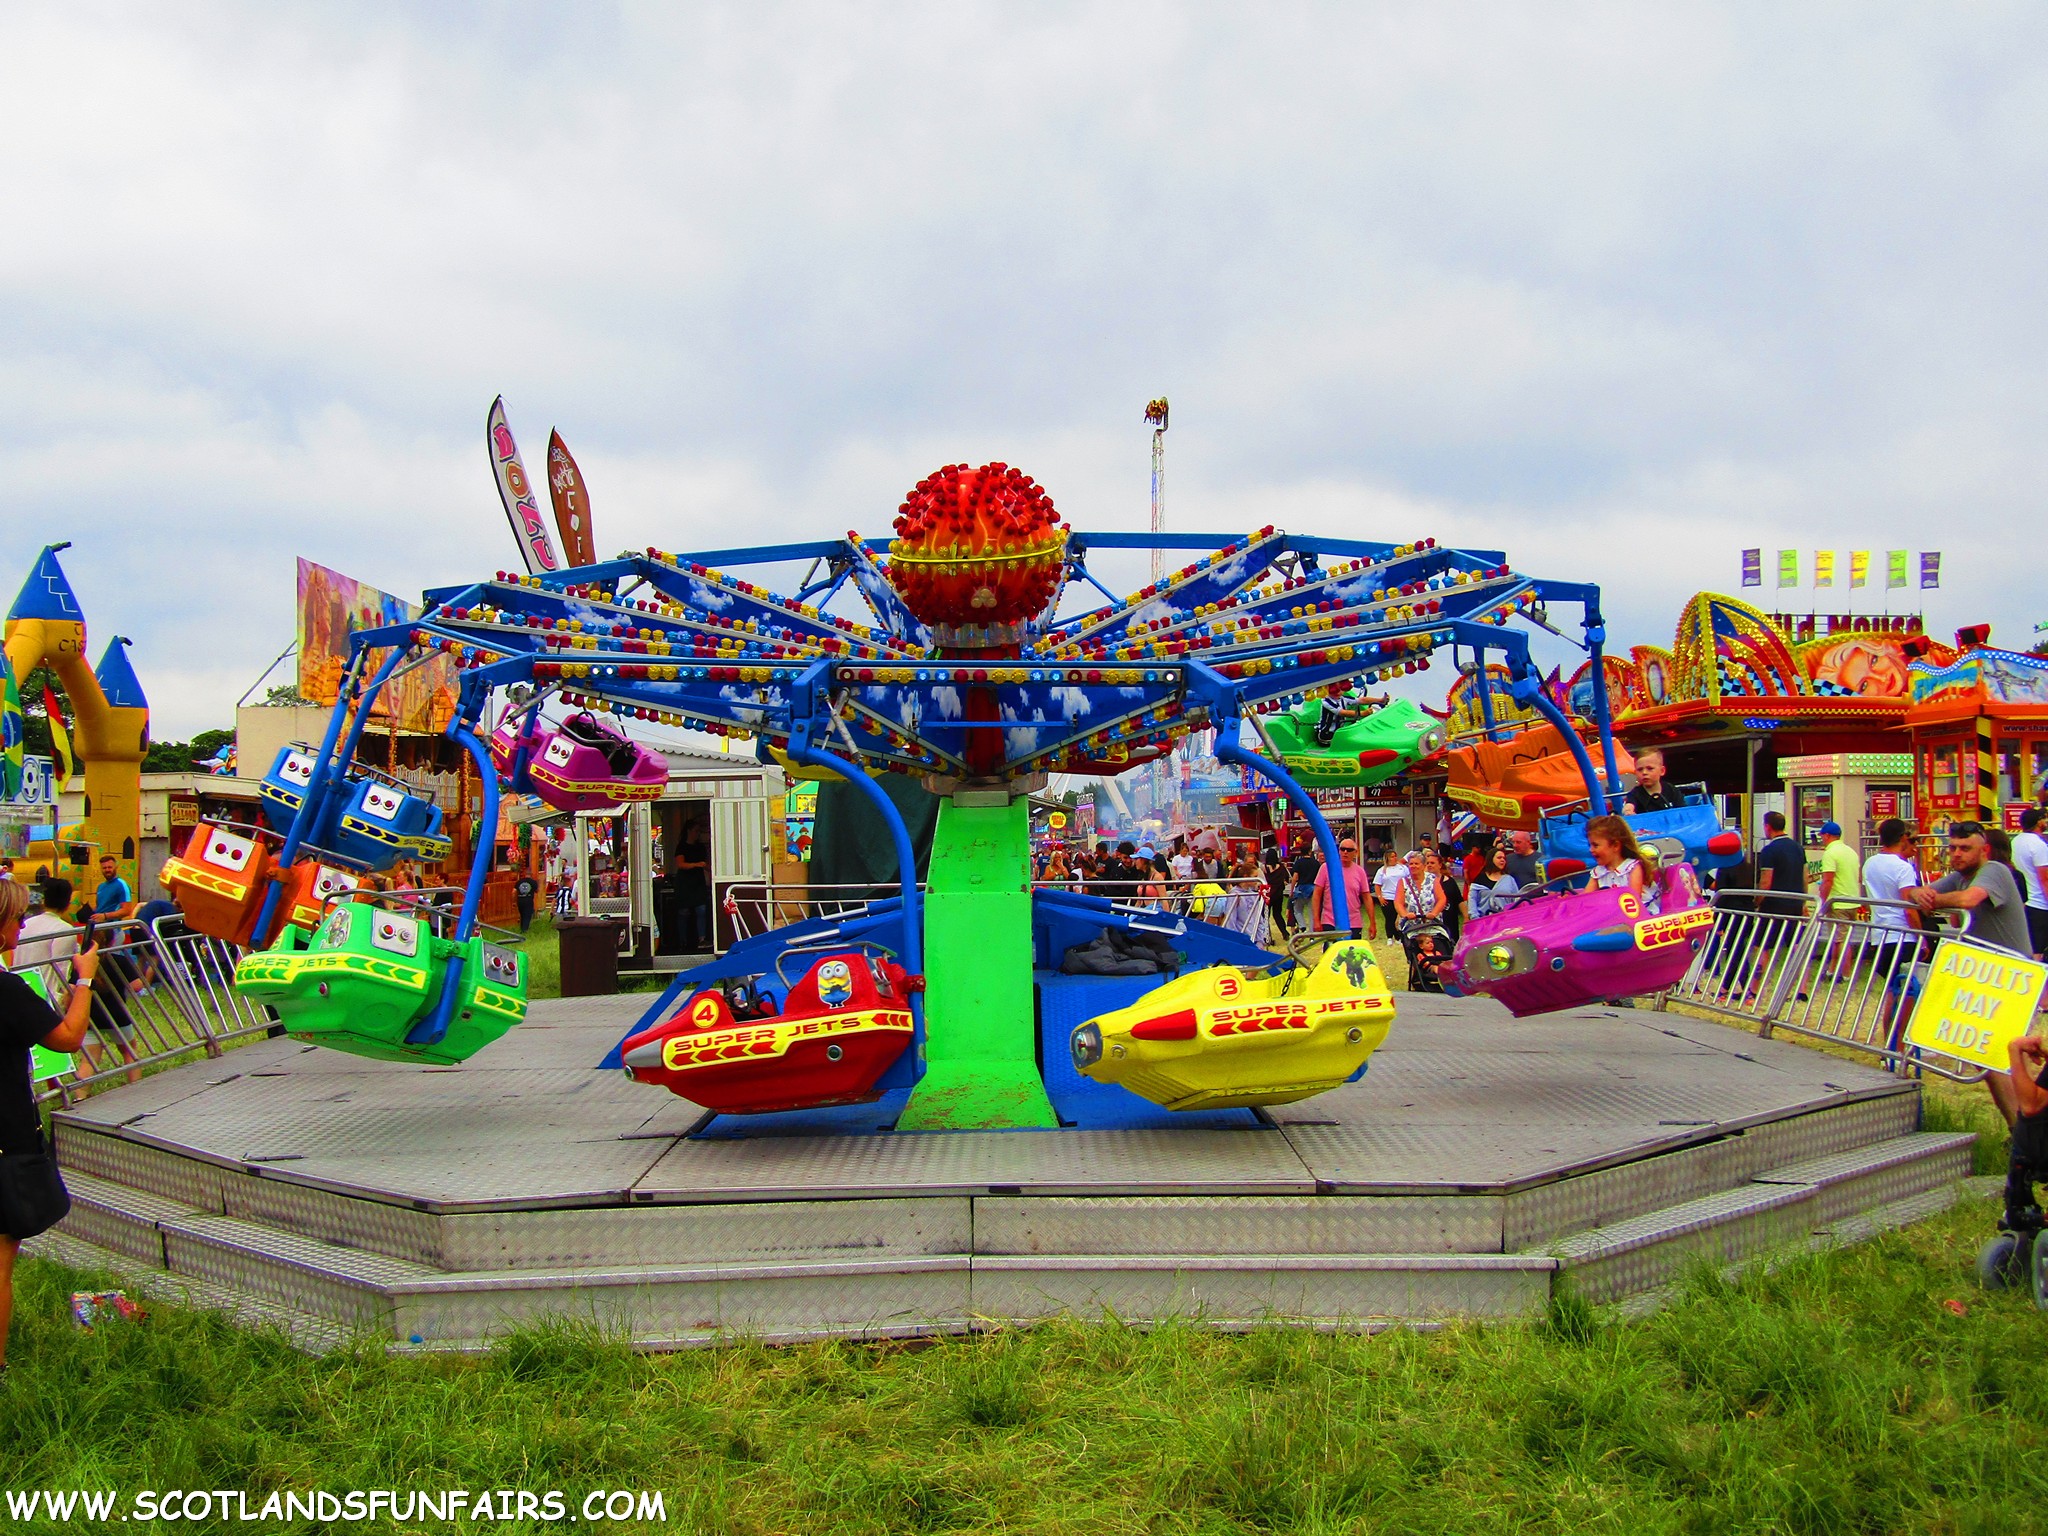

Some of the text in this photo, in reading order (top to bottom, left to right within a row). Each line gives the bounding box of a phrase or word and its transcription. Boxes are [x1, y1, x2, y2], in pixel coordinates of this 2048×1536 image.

[576, 784, 626, 792] SUPER
[403, 838, 435, 848] SUPER
[1623, 898, 1636, 913] 2
[1682, 911, 1712, 925] JETS
[239, 957, 337, 969] SUPER JETS
[1941, 952, 2033, 996] ADULTS
[1219, 978, 1238, 997] 3
[695, 1004, 714, 1022] 4
[1211, 998, 1382, 1022] SUPER JETS
[1951, 988, 2002, 1021] MAY
[674, 1017, 861, 1052] SUPER JETS
[1934, 1018, 1993, 1054] RIDE
